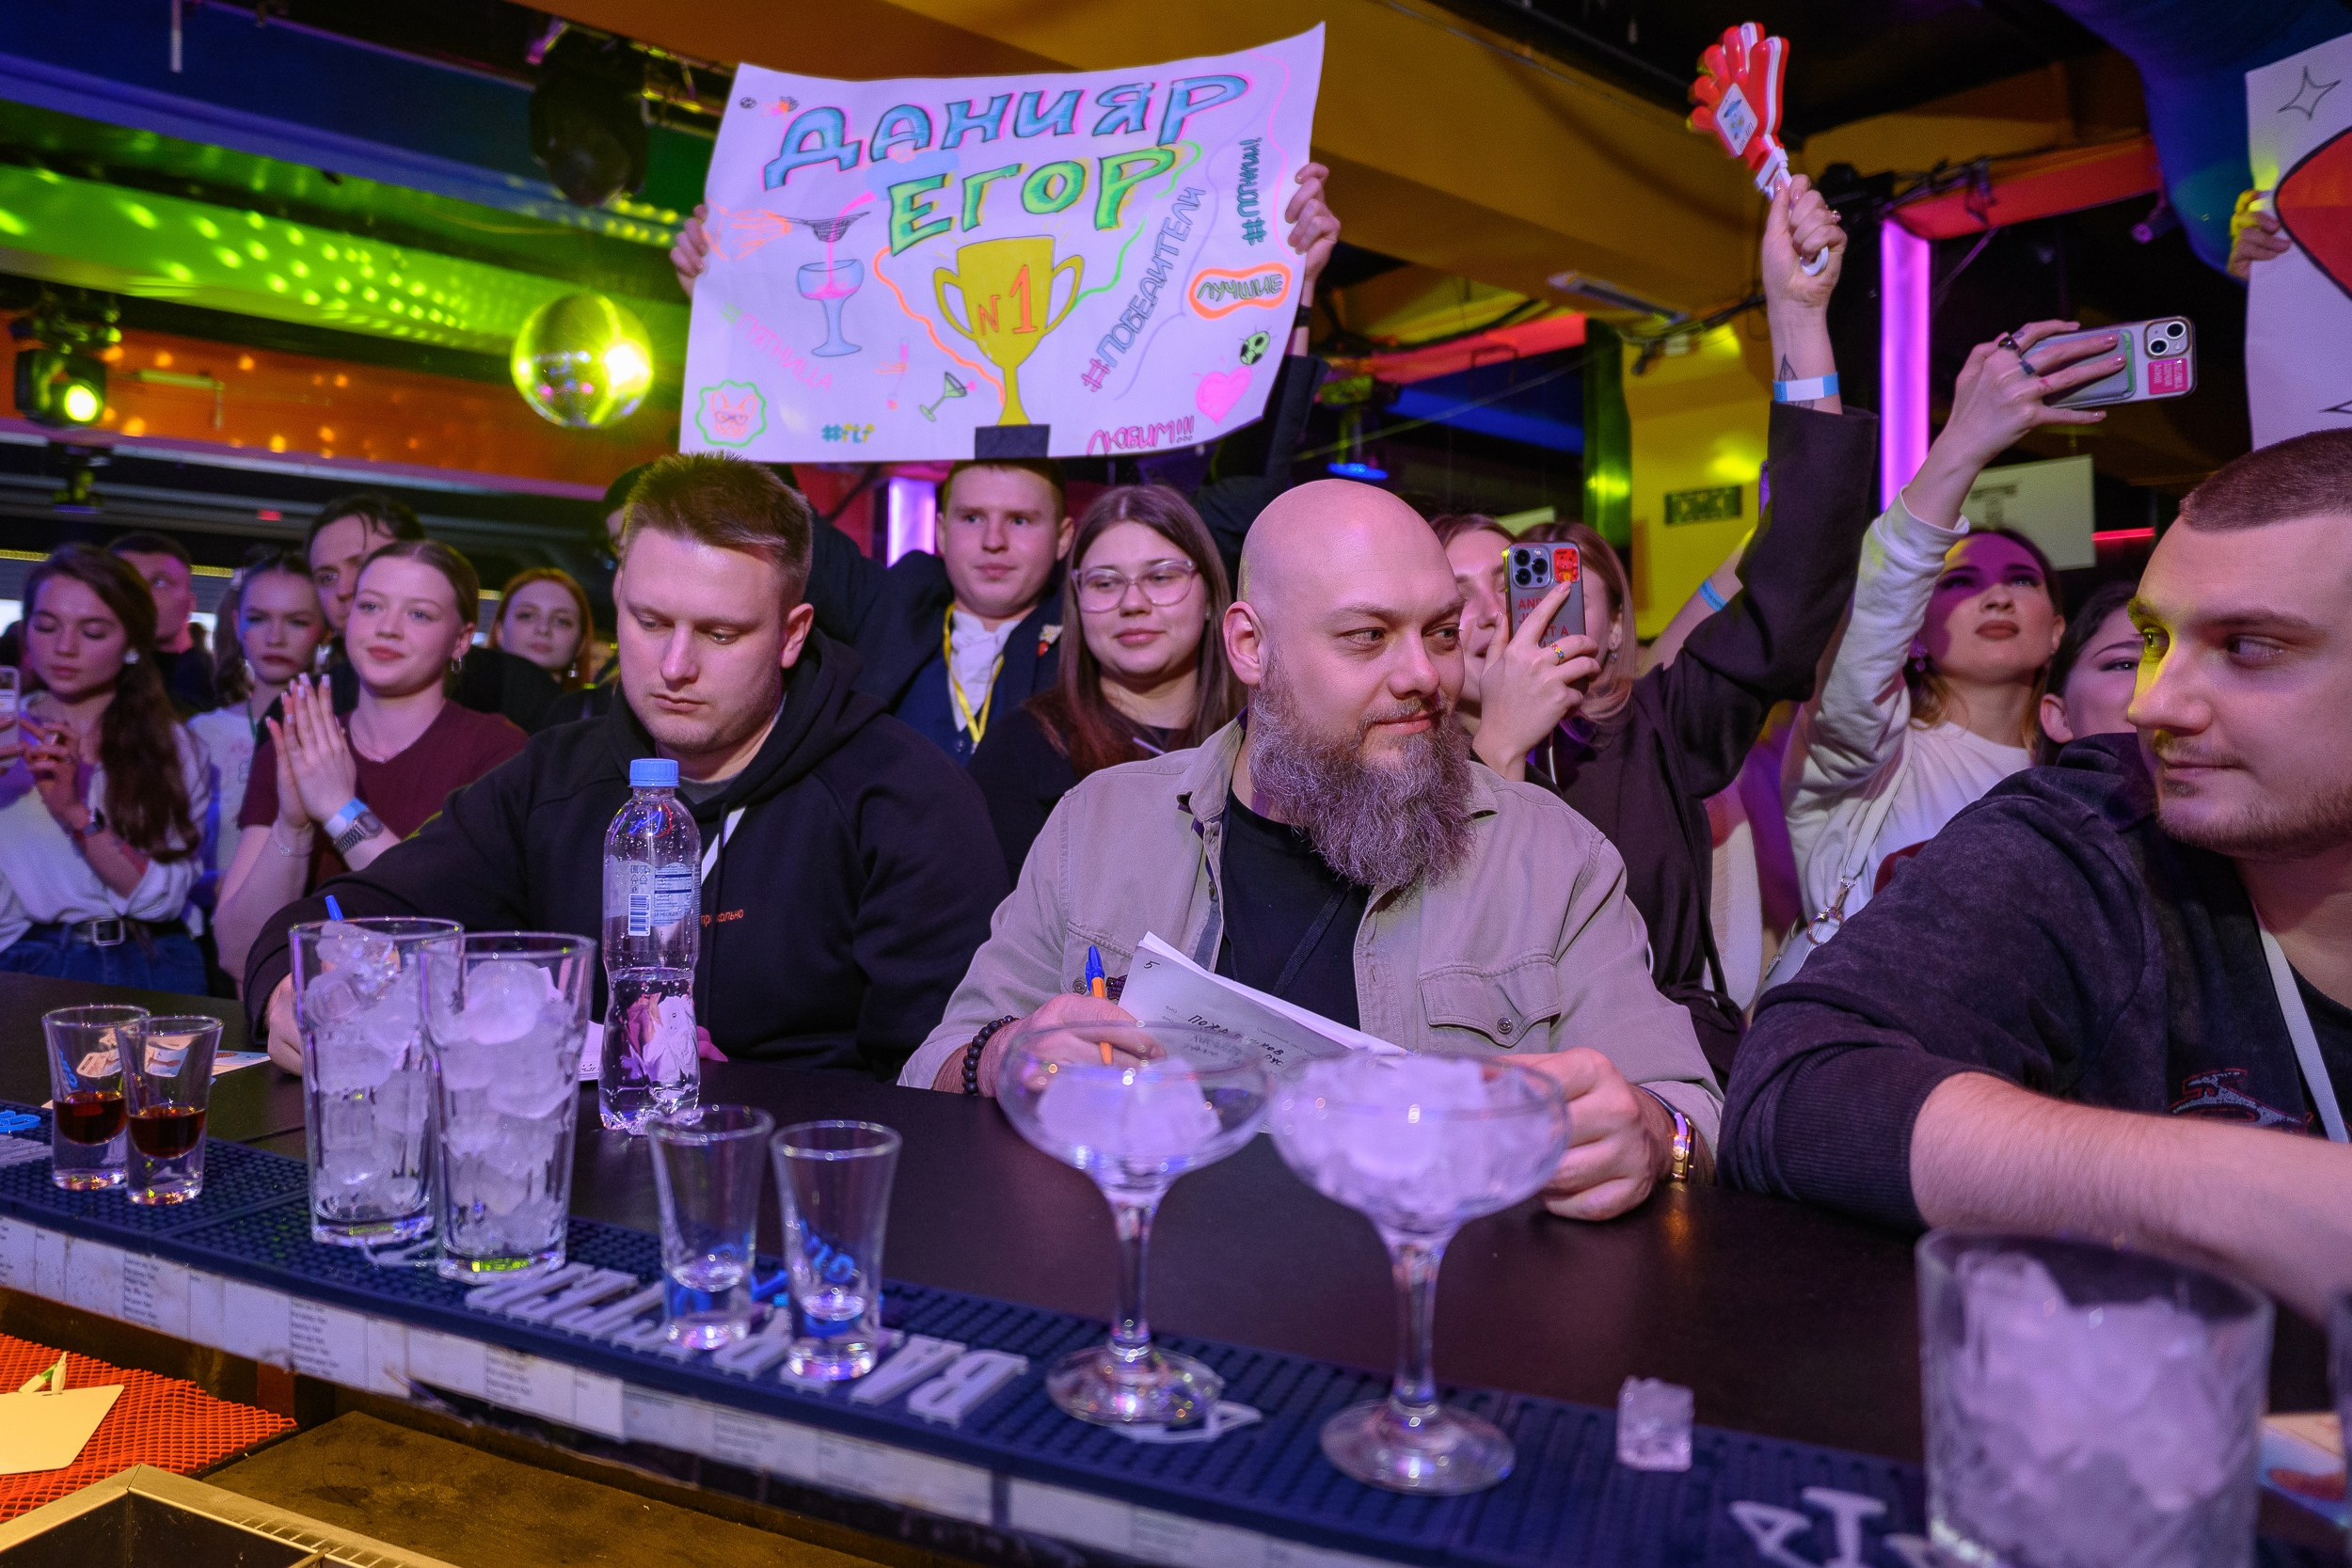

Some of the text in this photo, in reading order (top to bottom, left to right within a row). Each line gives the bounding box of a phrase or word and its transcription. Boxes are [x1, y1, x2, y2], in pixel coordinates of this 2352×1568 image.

[763, 74, 1250, 191] ДАНИЯР
[887, 146, 1178, 256] ЕГОР
[1082, 186, 1207, 393] #ПОБЕДИТЕЛИ
[1197, 273, 1283, 303] ЛУЧШИЕ
[1087, 415, 1195, 455] ЛЮБИМ!!!
[1143, 959, 1161, 970] 5
